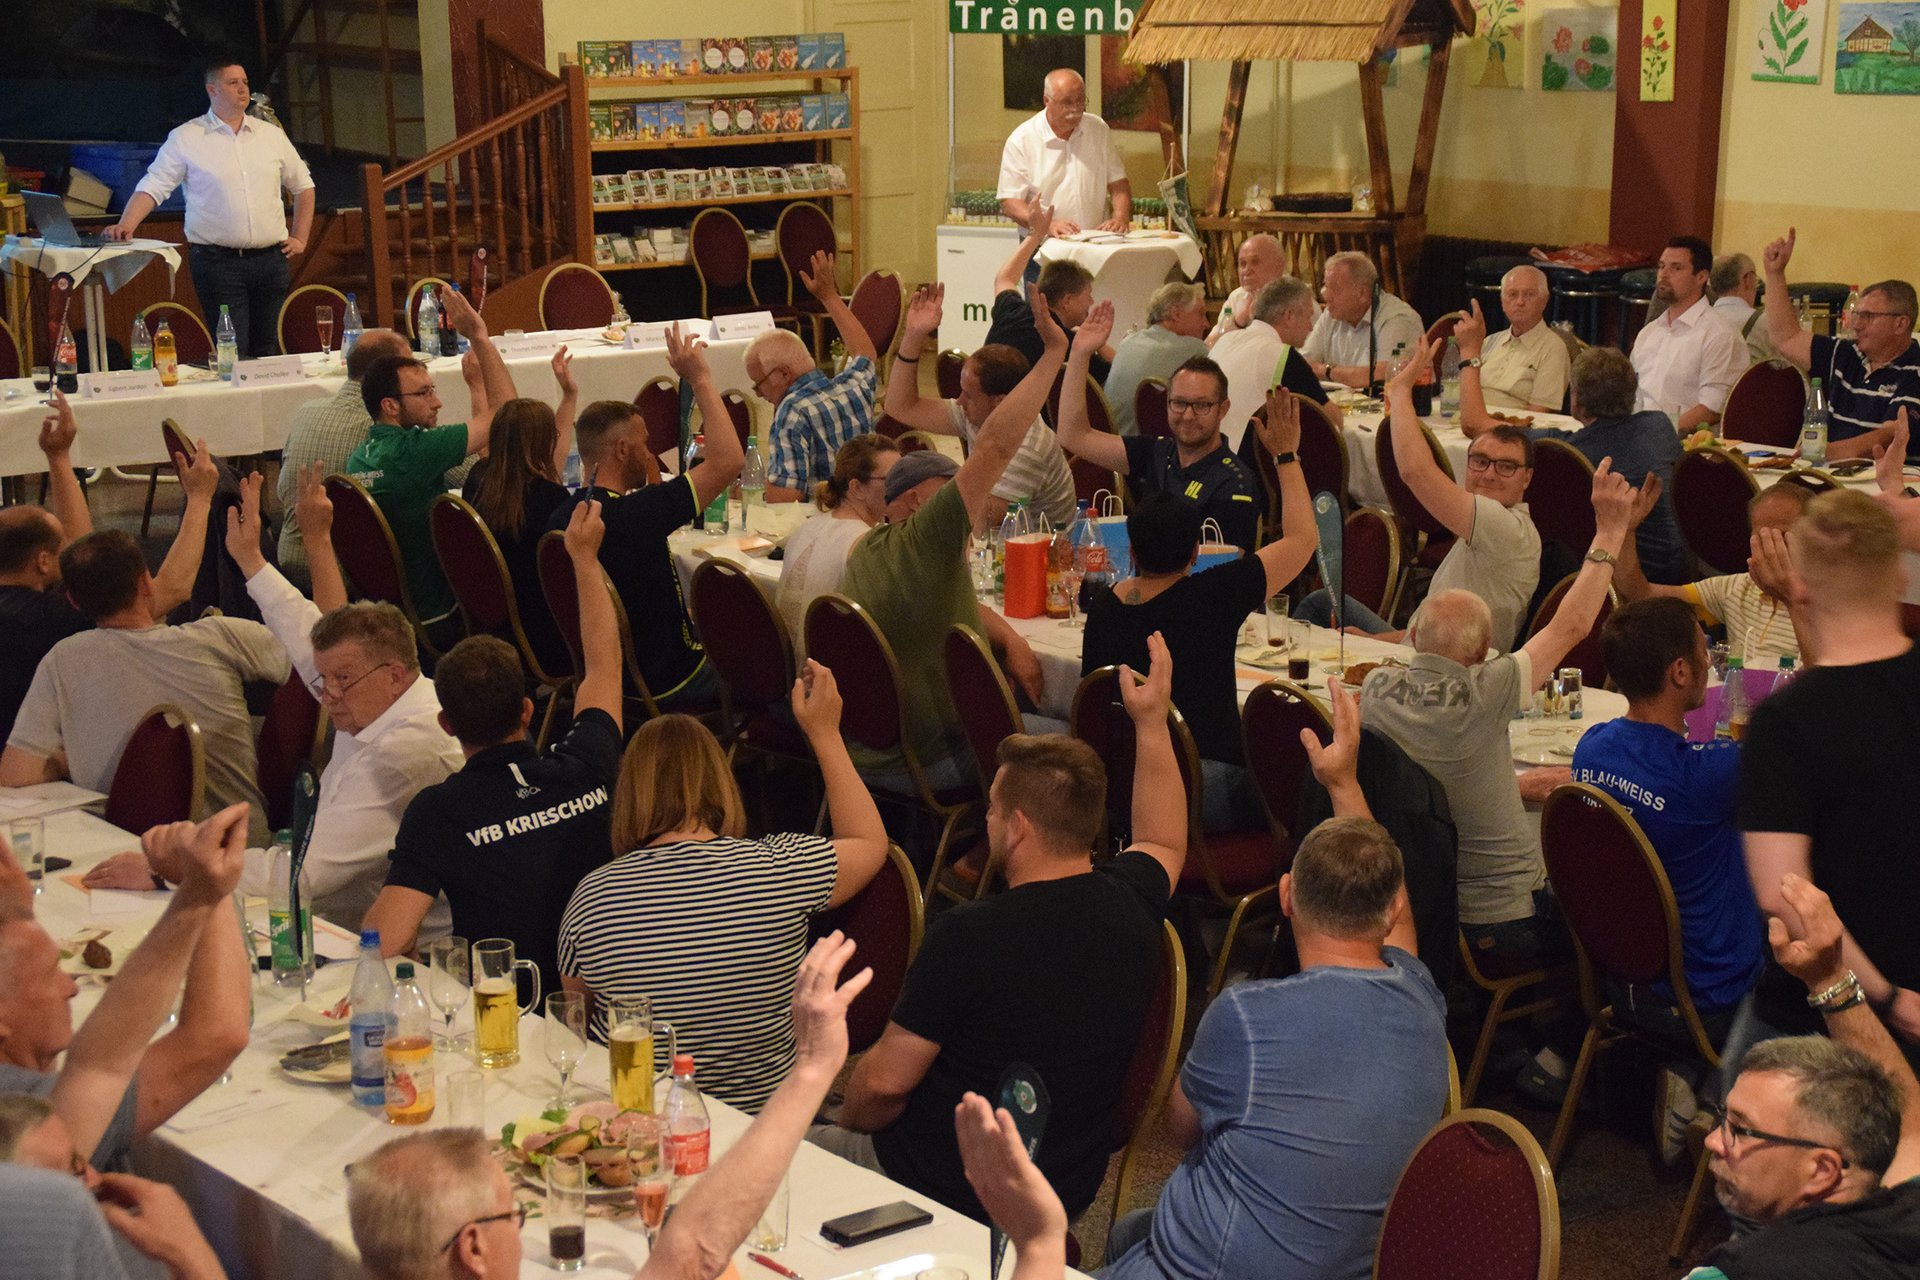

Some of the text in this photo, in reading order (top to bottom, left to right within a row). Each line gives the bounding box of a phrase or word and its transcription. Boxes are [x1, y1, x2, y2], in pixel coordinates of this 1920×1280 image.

[1184, 480, 1203, 499] HL
[1581, 768, 1666, 811] BLAU-WEISS
[466, 785, 608, 847] VfB KRIESCHOW
